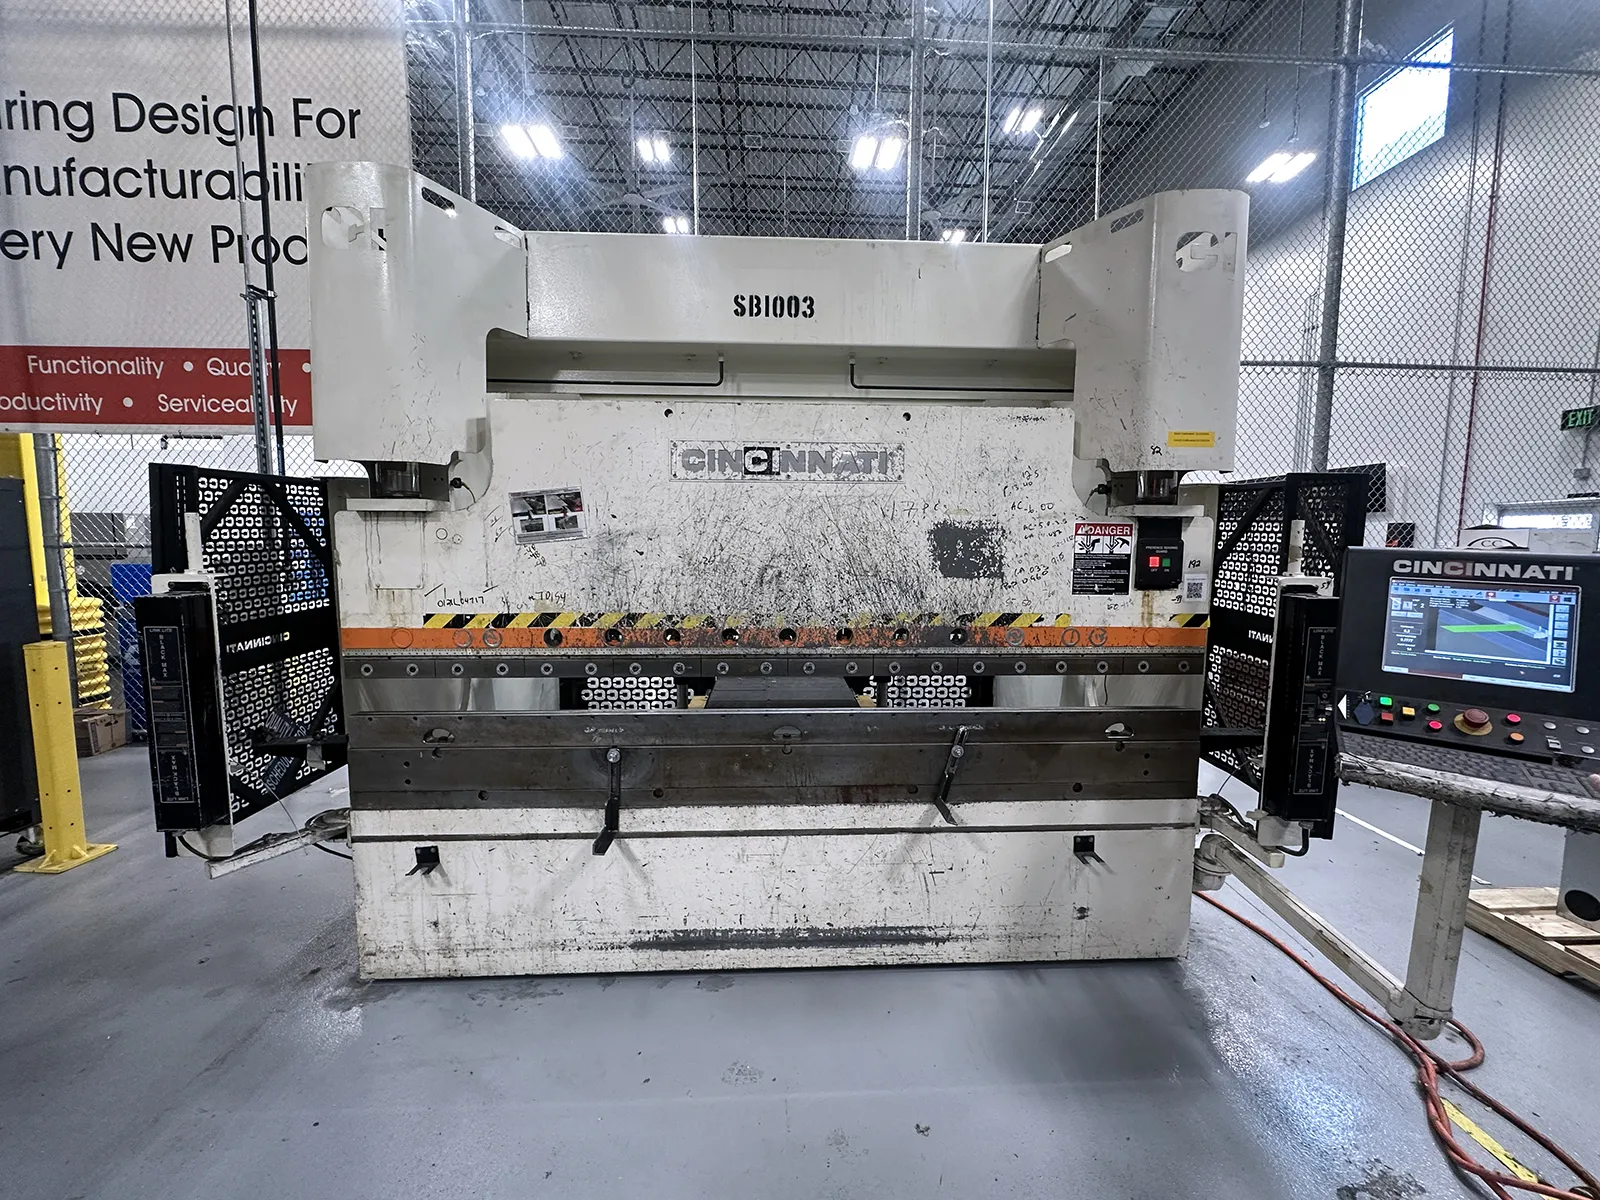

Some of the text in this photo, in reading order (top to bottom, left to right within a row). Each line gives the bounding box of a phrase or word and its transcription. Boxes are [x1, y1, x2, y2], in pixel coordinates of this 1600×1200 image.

[0, 90, 361, 147] ring Design For
[2, 156, 306, 202] nufacturabili
[0, 229, 73, 270] ery
[91, 221, 194, 263] New
[27, 355, 164, 379] Functionality
[0, 392, 103, 416] oductivity
[1568, 409, 1594, 427] EXIT
[681, 447, 888, 476] CINCINNATI
[1088, 526, 1131, 535] DANGER
[1393, 559, 1574, 581] CINCINNATI
